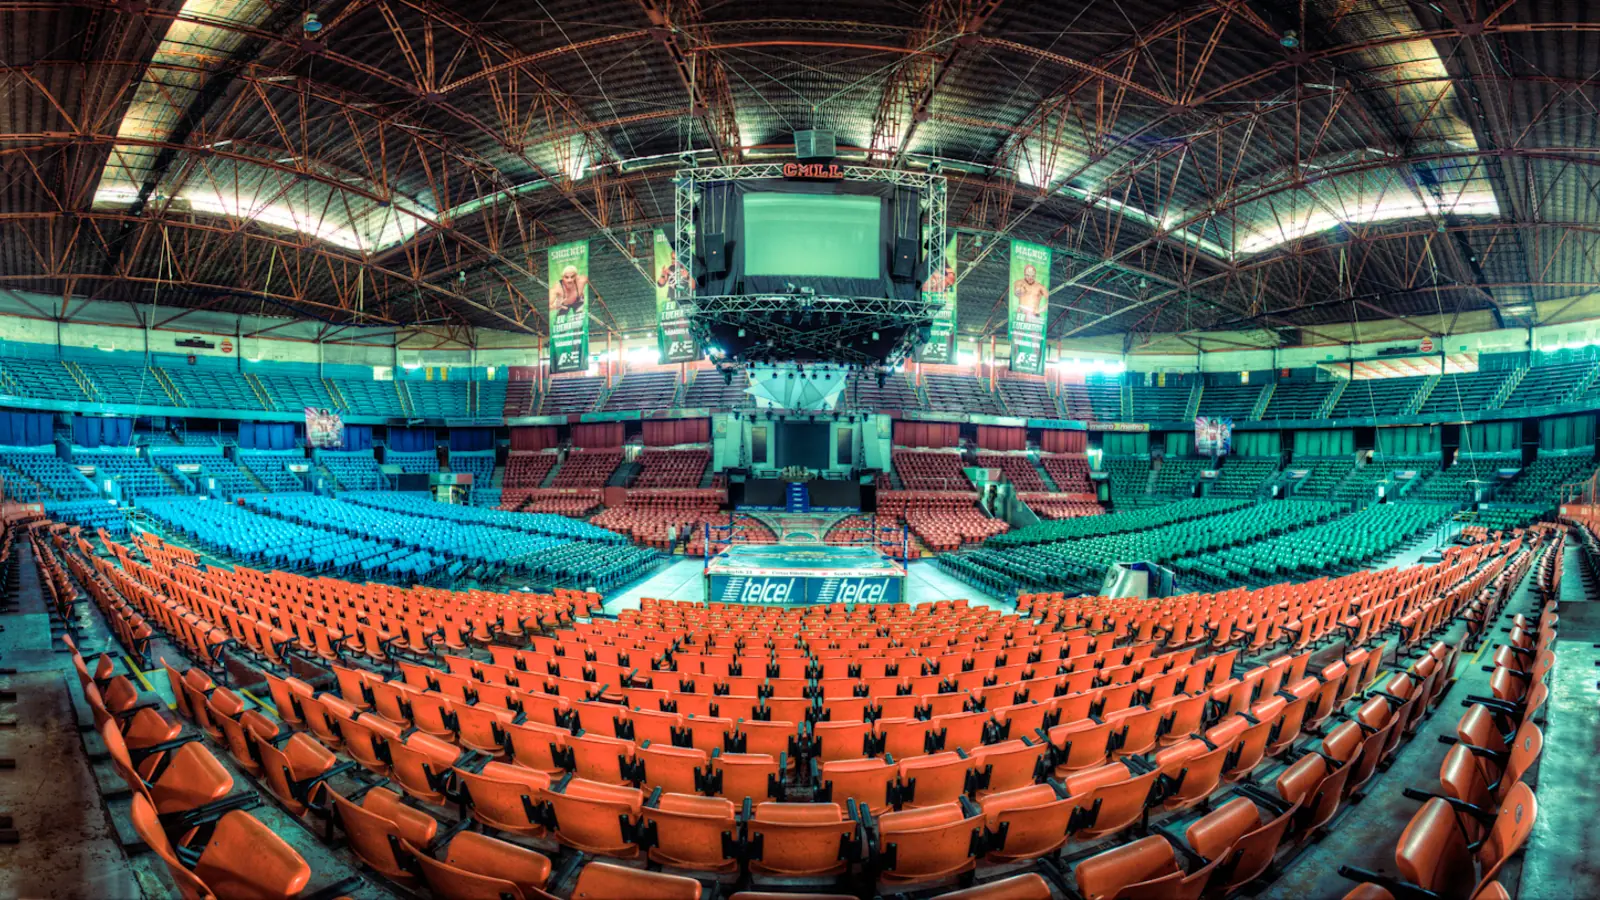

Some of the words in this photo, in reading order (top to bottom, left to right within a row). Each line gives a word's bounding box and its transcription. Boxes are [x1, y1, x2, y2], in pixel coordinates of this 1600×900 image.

[784, 163, 843, 178] CMLL
[1015, 245, 1048, 260] MAGNUS
[668, 341, 694, 355] A&E
[922, 343, 948, 356] A&E
[558, 351, 580, 365] A&E
[1015, 352, 1037, 366] A&E
[740, 577, 796, 604] telcel
[835, 578, 890, 604] telcel
